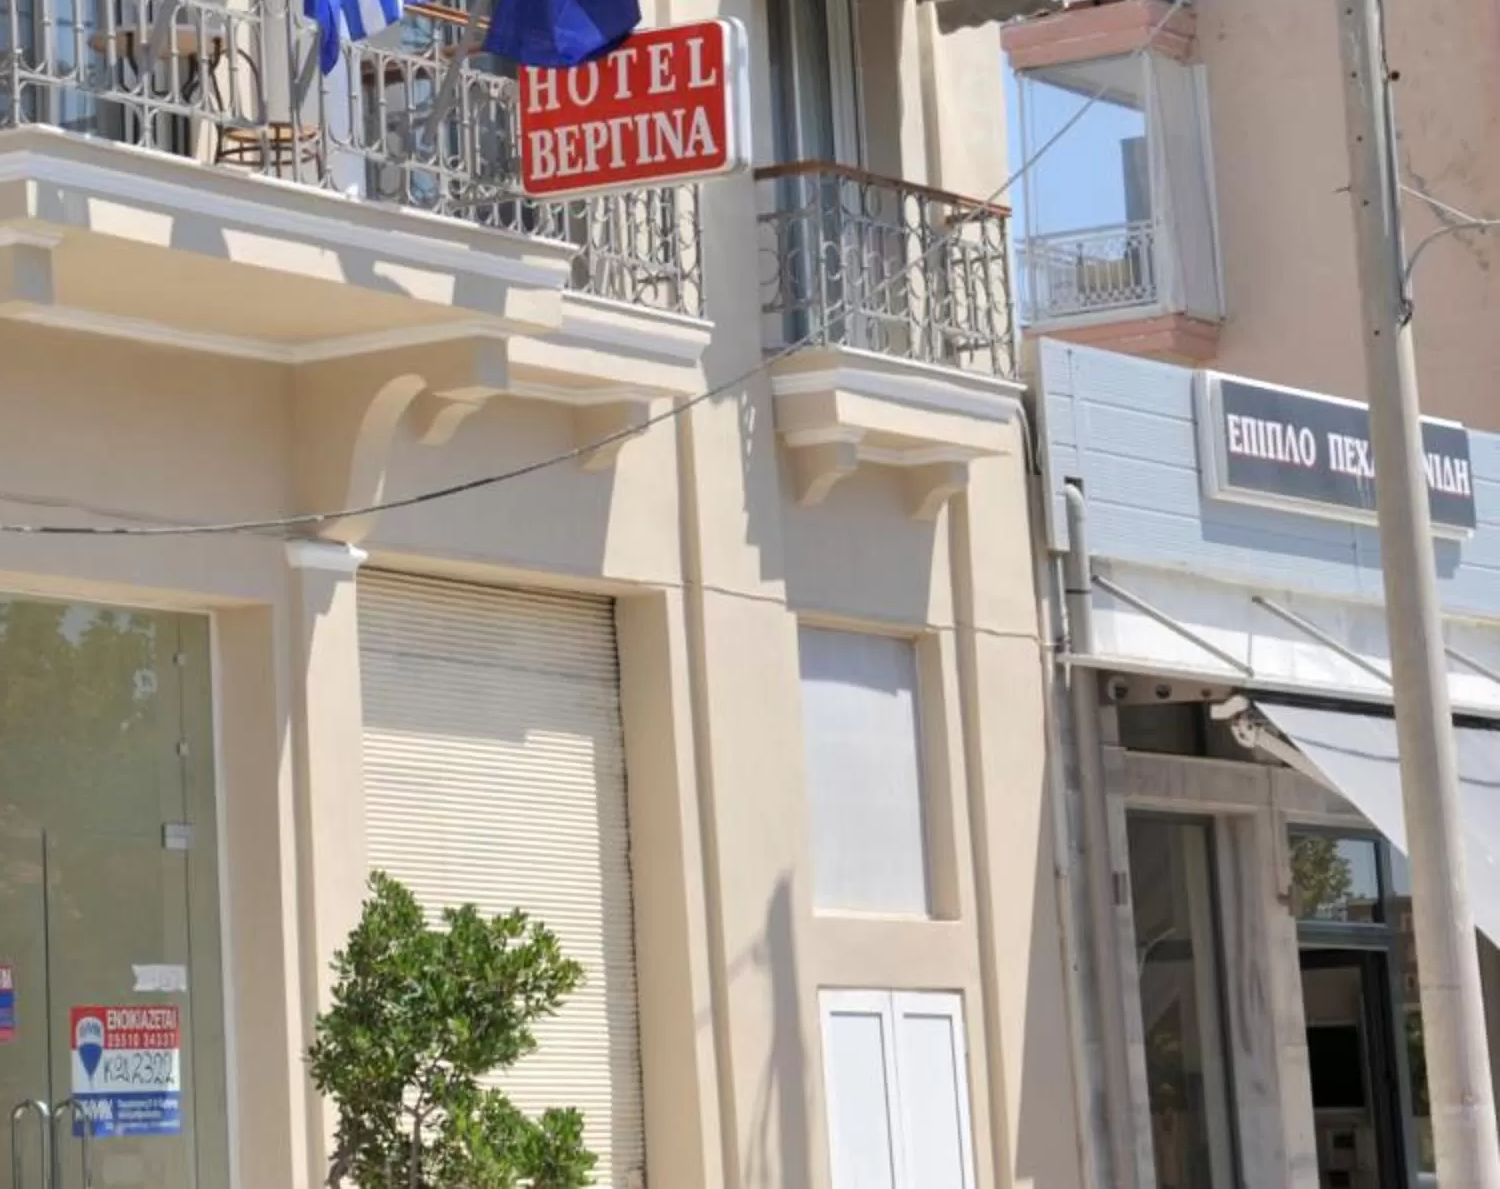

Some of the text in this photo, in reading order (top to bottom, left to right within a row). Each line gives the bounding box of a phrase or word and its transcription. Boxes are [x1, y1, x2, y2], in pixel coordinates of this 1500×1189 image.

[524, 37, 717, 115] HOTEL
[527, 105, 719, 181] ΒΕΡΓΙΝΑ
[1227, 413, 1471, 497] ΕΠΙΠΛΟ ΠΕΧΝΙΔΗ
